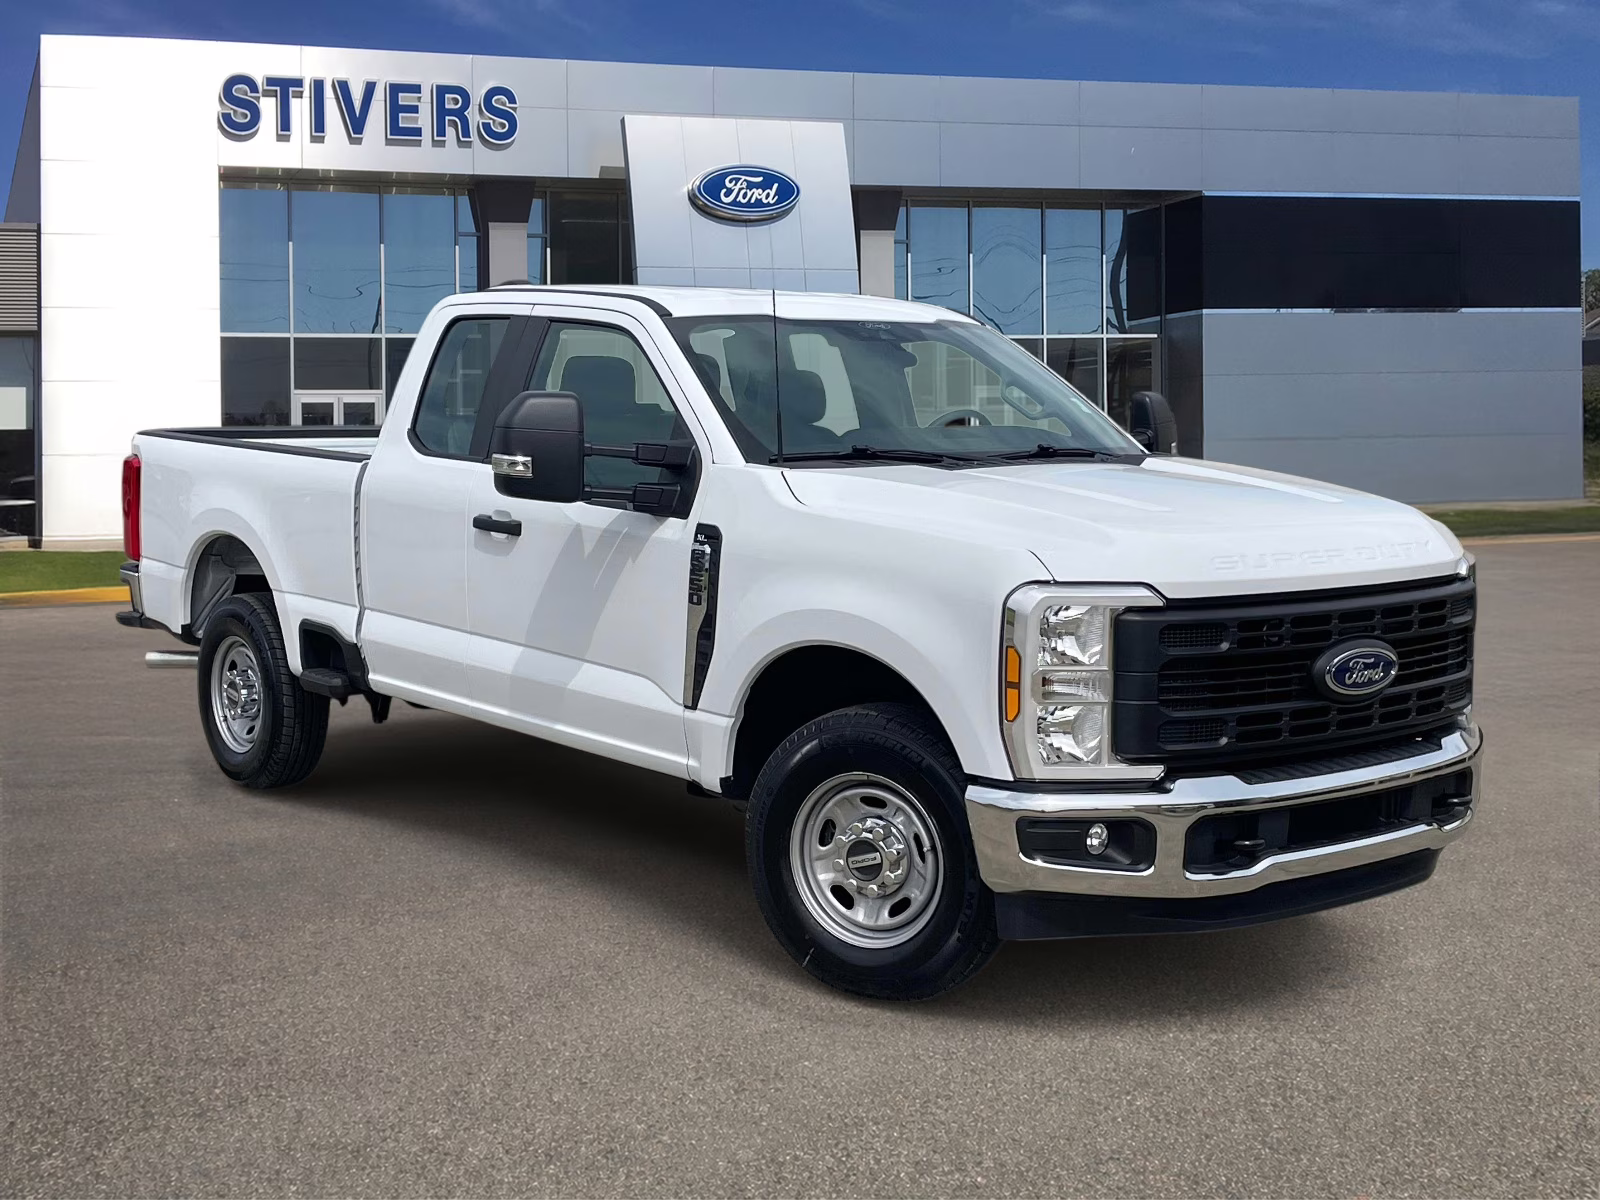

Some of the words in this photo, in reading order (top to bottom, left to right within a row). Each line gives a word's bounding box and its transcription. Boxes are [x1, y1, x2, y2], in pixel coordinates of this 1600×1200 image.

[218, 73, 518, 149] STIVERS
[720, 174, 779, 204] Ford
[697, 533, 708, 542] XL
[1344, 657, 1385, 685] Ford
